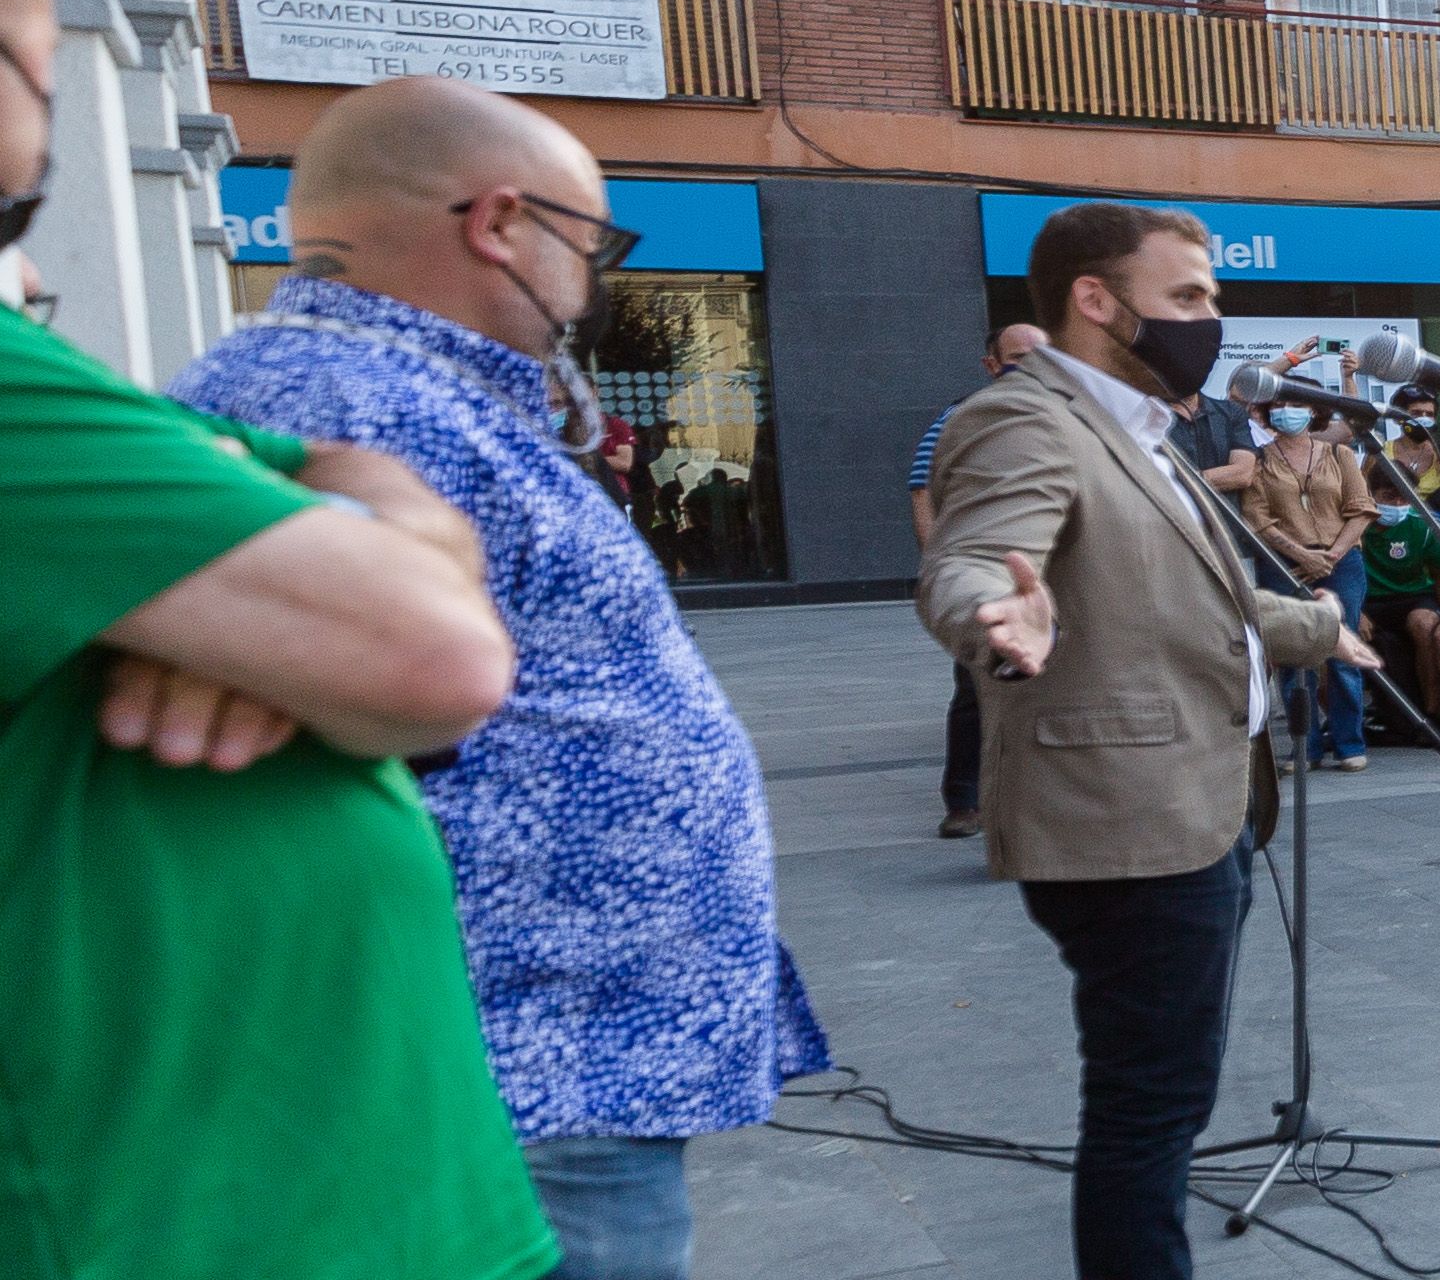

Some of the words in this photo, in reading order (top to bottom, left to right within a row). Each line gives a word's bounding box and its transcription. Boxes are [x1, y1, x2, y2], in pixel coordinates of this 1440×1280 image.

[396, 9, 520, 33] LISBONA
[280, 33, 375, 50] MEDICINA
[380, 40, 429, 54] GRAL
[443, 44, 565, 61] ACUPUNTURA
[581, 52, 629, 66] LASER
[437, 61, 565, 84] 6915555
[1247, 342, 1284, 351] cuidem
